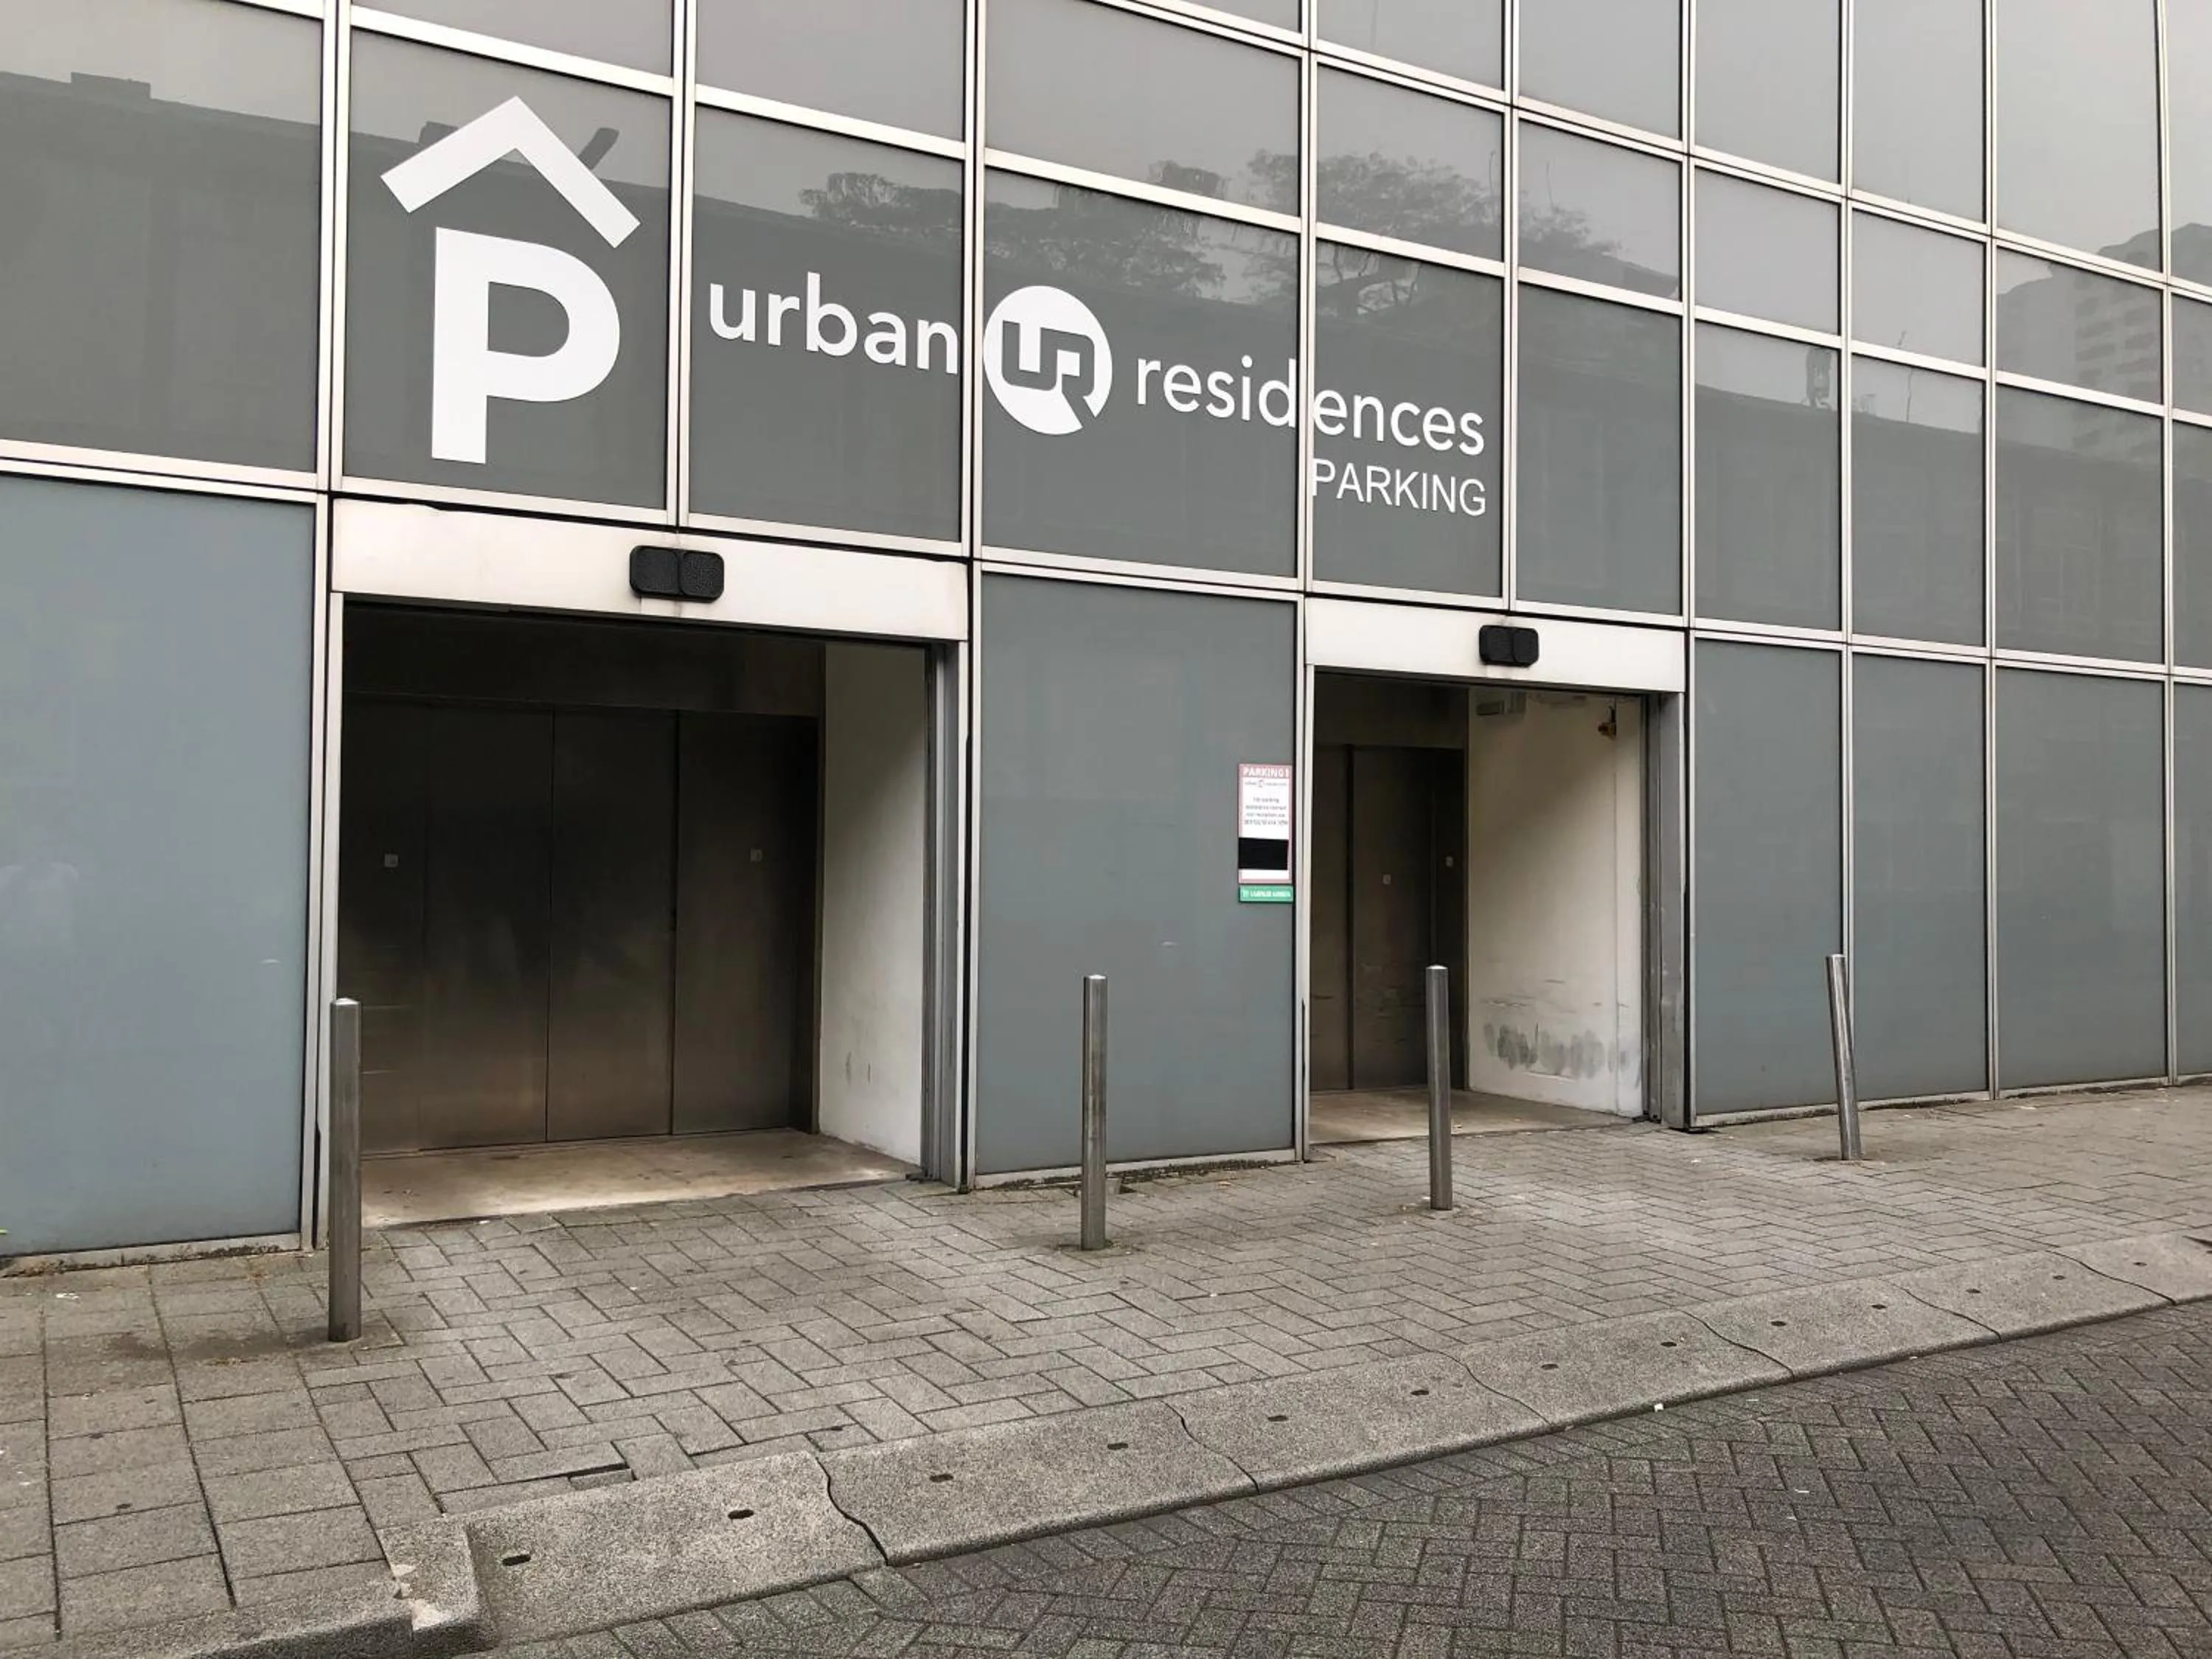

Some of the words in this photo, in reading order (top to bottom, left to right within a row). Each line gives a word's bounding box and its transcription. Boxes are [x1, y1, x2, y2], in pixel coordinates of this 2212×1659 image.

[432, 226, 621, 465] P
[710, 271, 958, 375] urban
[1137, 355, 1485, 455] residences
[1312, 458, 1486, 516] PARKING
